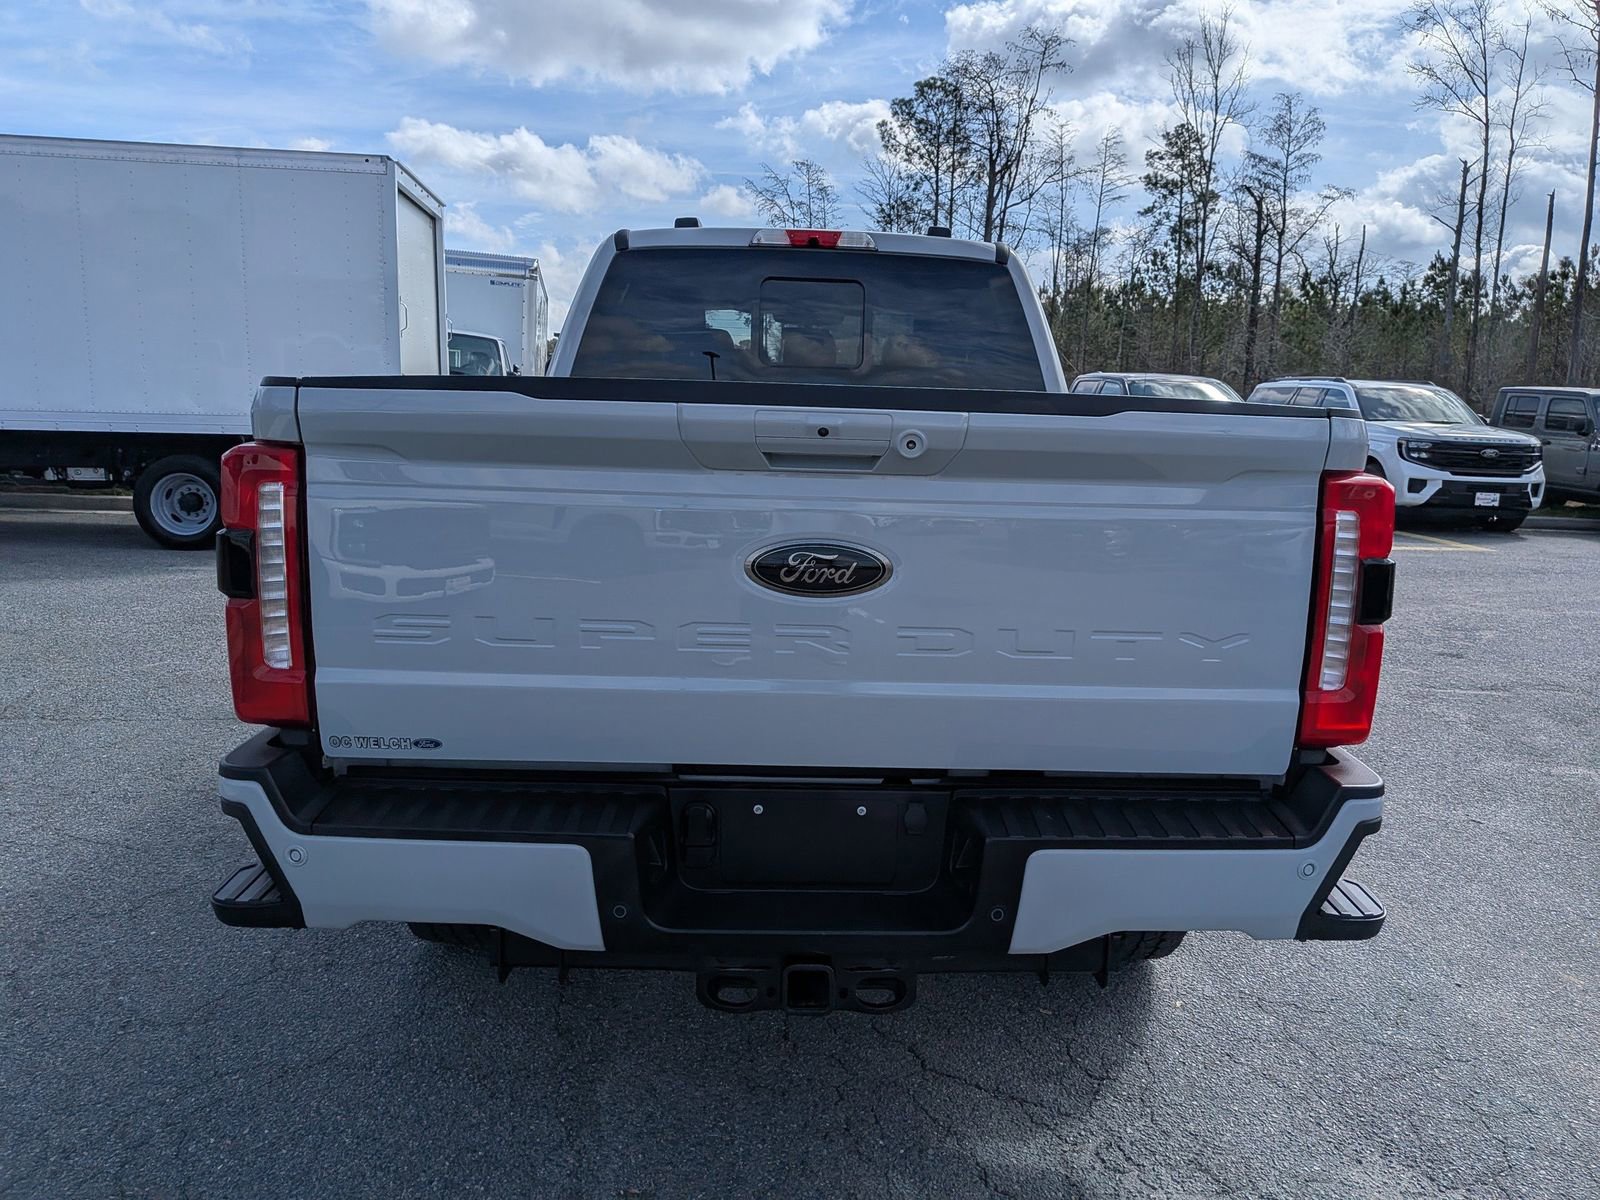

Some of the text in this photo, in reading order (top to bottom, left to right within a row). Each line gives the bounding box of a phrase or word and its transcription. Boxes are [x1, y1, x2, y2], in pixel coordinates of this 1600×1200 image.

[779, 551, 858, 584] Ford
[373, 613, 1250, 662] SUPER DUTY
[328, 735, 353, 748] OC
[353, 736, 413, 750] WELCH
